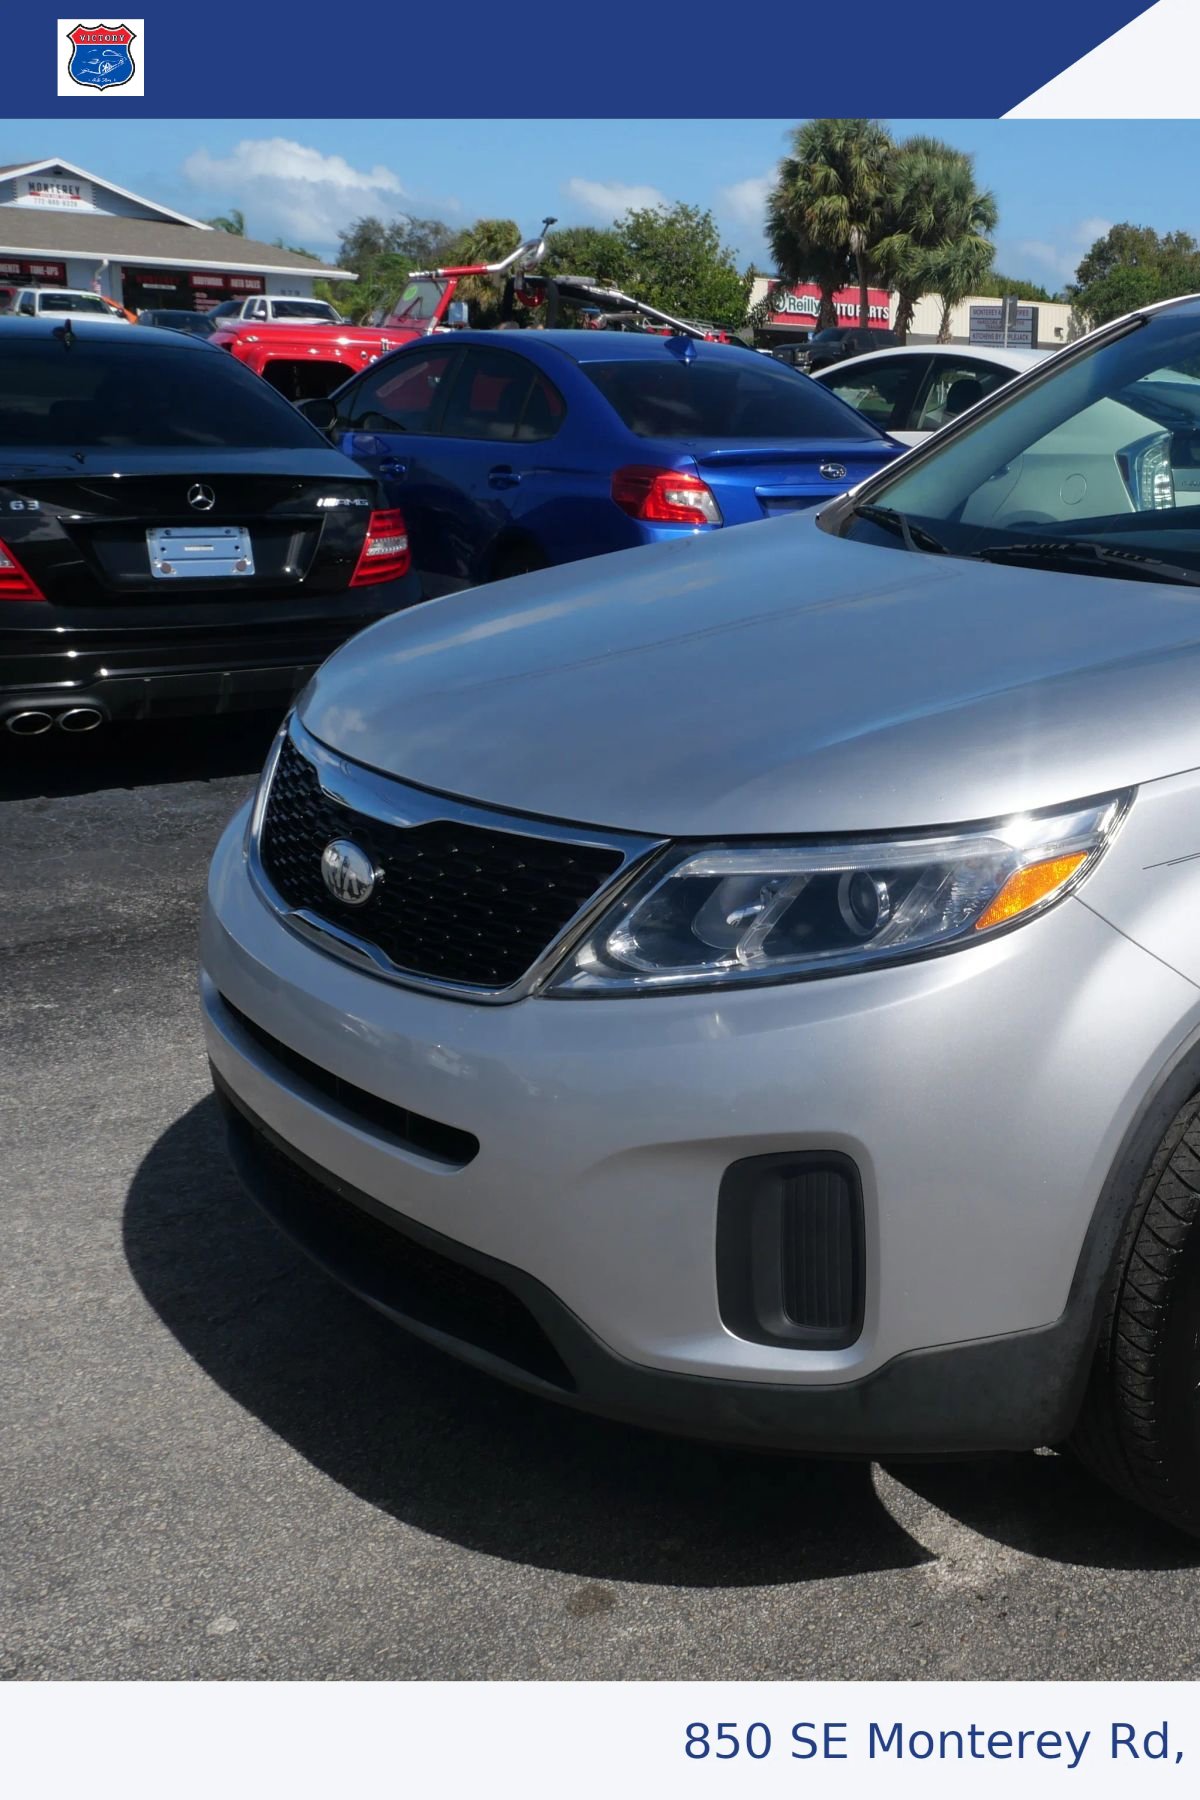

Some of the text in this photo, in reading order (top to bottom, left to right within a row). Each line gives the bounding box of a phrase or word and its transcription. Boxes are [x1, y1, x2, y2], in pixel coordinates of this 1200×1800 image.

[28, 181, 80, 195] MONTEREY
[856, 303, 890, 319] PRTS
[10, 500, 40, 511] 63
